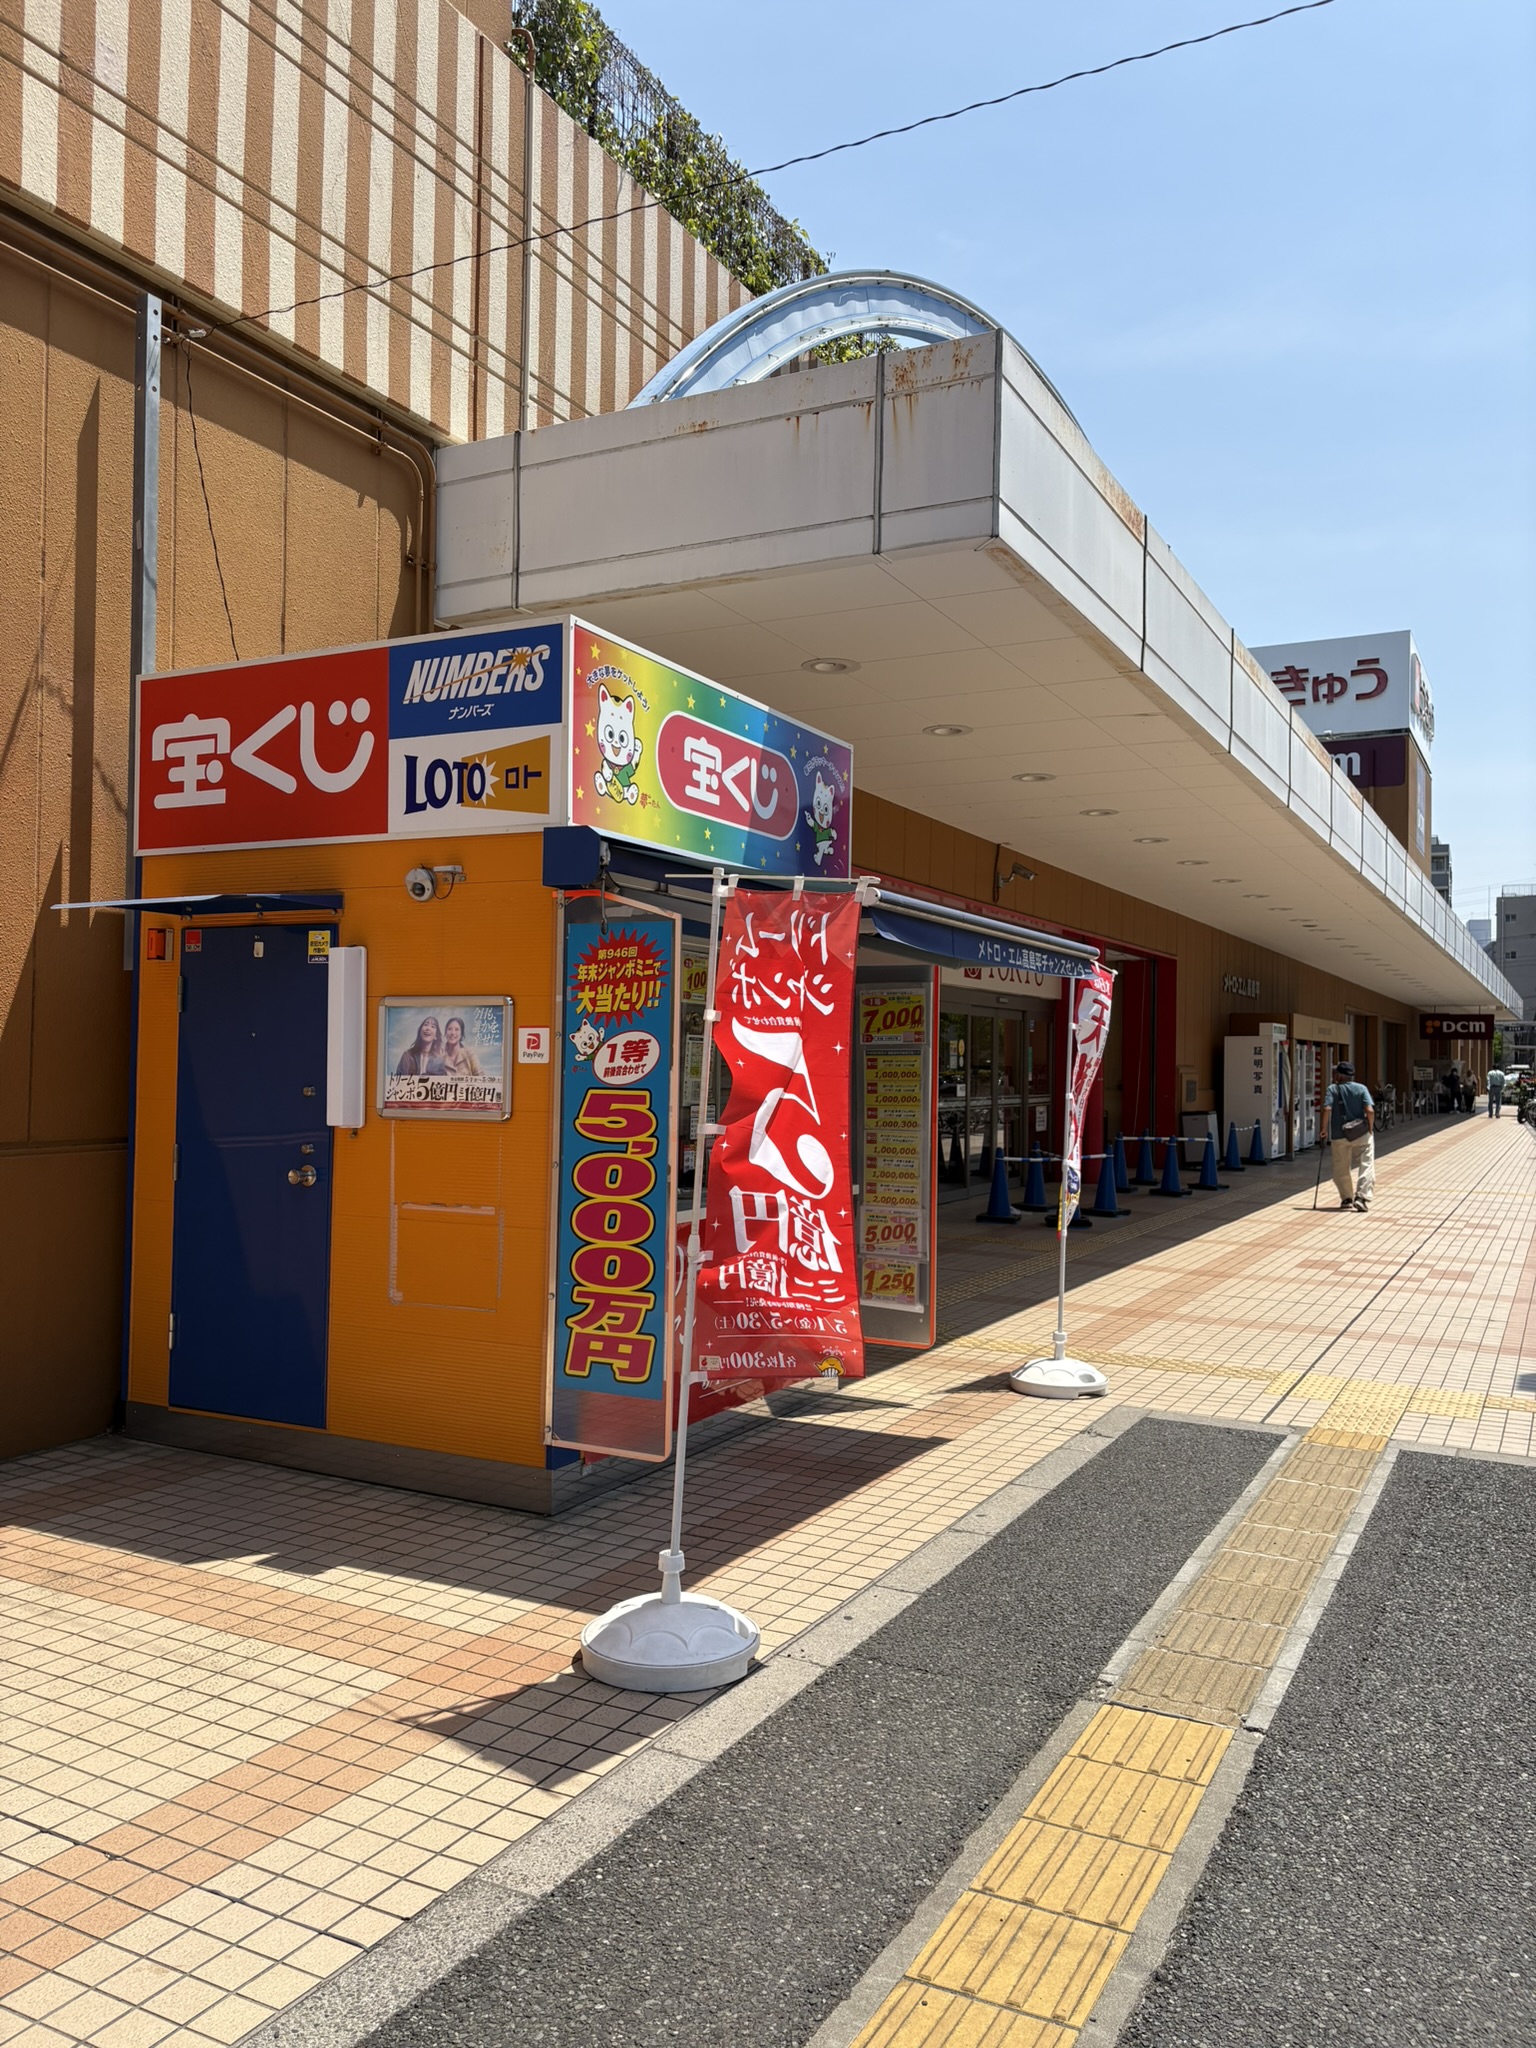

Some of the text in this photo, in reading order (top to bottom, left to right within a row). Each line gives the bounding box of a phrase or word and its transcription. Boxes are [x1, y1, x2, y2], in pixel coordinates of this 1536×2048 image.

[403, 643, 551, 705] NUMBERS
[448, 702, 495, 720] ナンバーズ
[152, 697, 375, 809] 宝くじ
[403, 754, 543, 815] LOTO ロト
[683, 736, 778, 819] 宝くじ
[577, 958, 661, 982] 年末ジャンボミニで
[597, 946, 638, 961] 第946回
[575, 980, 661, 1015] 大当たり!!
[523, 1051, 545, 1059] PayPay
[606, 1039, 651, 1063] 1等
[1253, 1046, 1263, 1094] 証明写真
[417, 1077, 458, 1101] 5億円
[564, 1088, 658, 1383] 5,000万円
